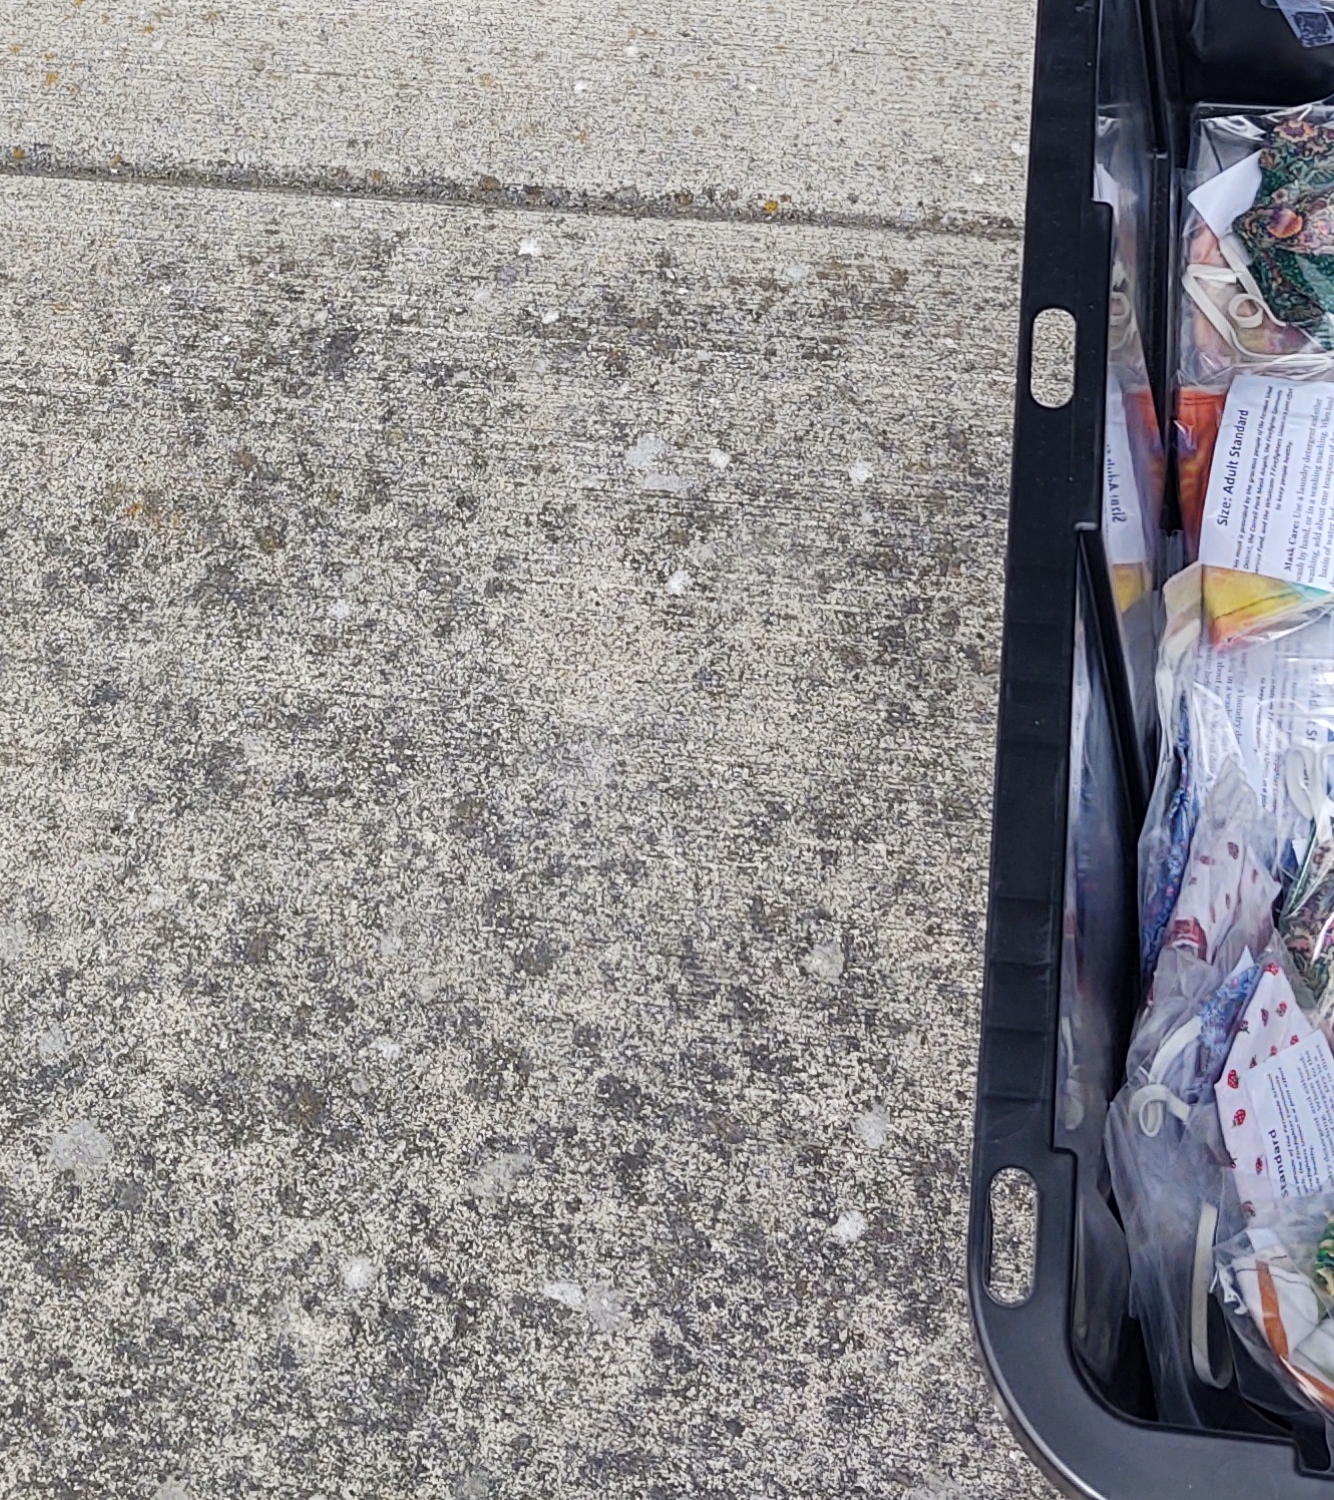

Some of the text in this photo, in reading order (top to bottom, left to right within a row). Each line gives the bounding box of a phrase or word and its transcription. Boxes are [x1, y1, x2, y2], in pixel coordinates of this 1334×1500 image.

[1319, 410, 1331, 428] When
[1301, 427, 1318, 463] detergent
[1216, 408, 1248, 526] Size: Adult Standard
[1279, 464, 1289, 485] people
[1295, 463, 1311, 495] laundry
[1307, 464, 1323, 497] washing
[1275, 485, 1285, 502] keep
[1319, 489, 1329, 506] one
[1274, 502, 1281, 510] to
[1291, 502, 1303, 518] Use
[1304, 504, 1314, 514] in
[1304, 515, 1313, 525] or
[1313, 506, 1327, 530] about
[1286, 519, 1300, 545] Care:
[1298, 525, 1312, 549] hand,
[1310, 531, 1322, 547] add
[1282, 546, 1295, 571] Mask
[1296, 549, 1308, 560] by
[1320, 545, 1332, 555] of
[1292, 560, 1305, 582] wash
[1317, 555, 1330, 578] basin
[1234, 694, 1245, 729] laundry
[1267, 1128, 1290, 1198] Standard
